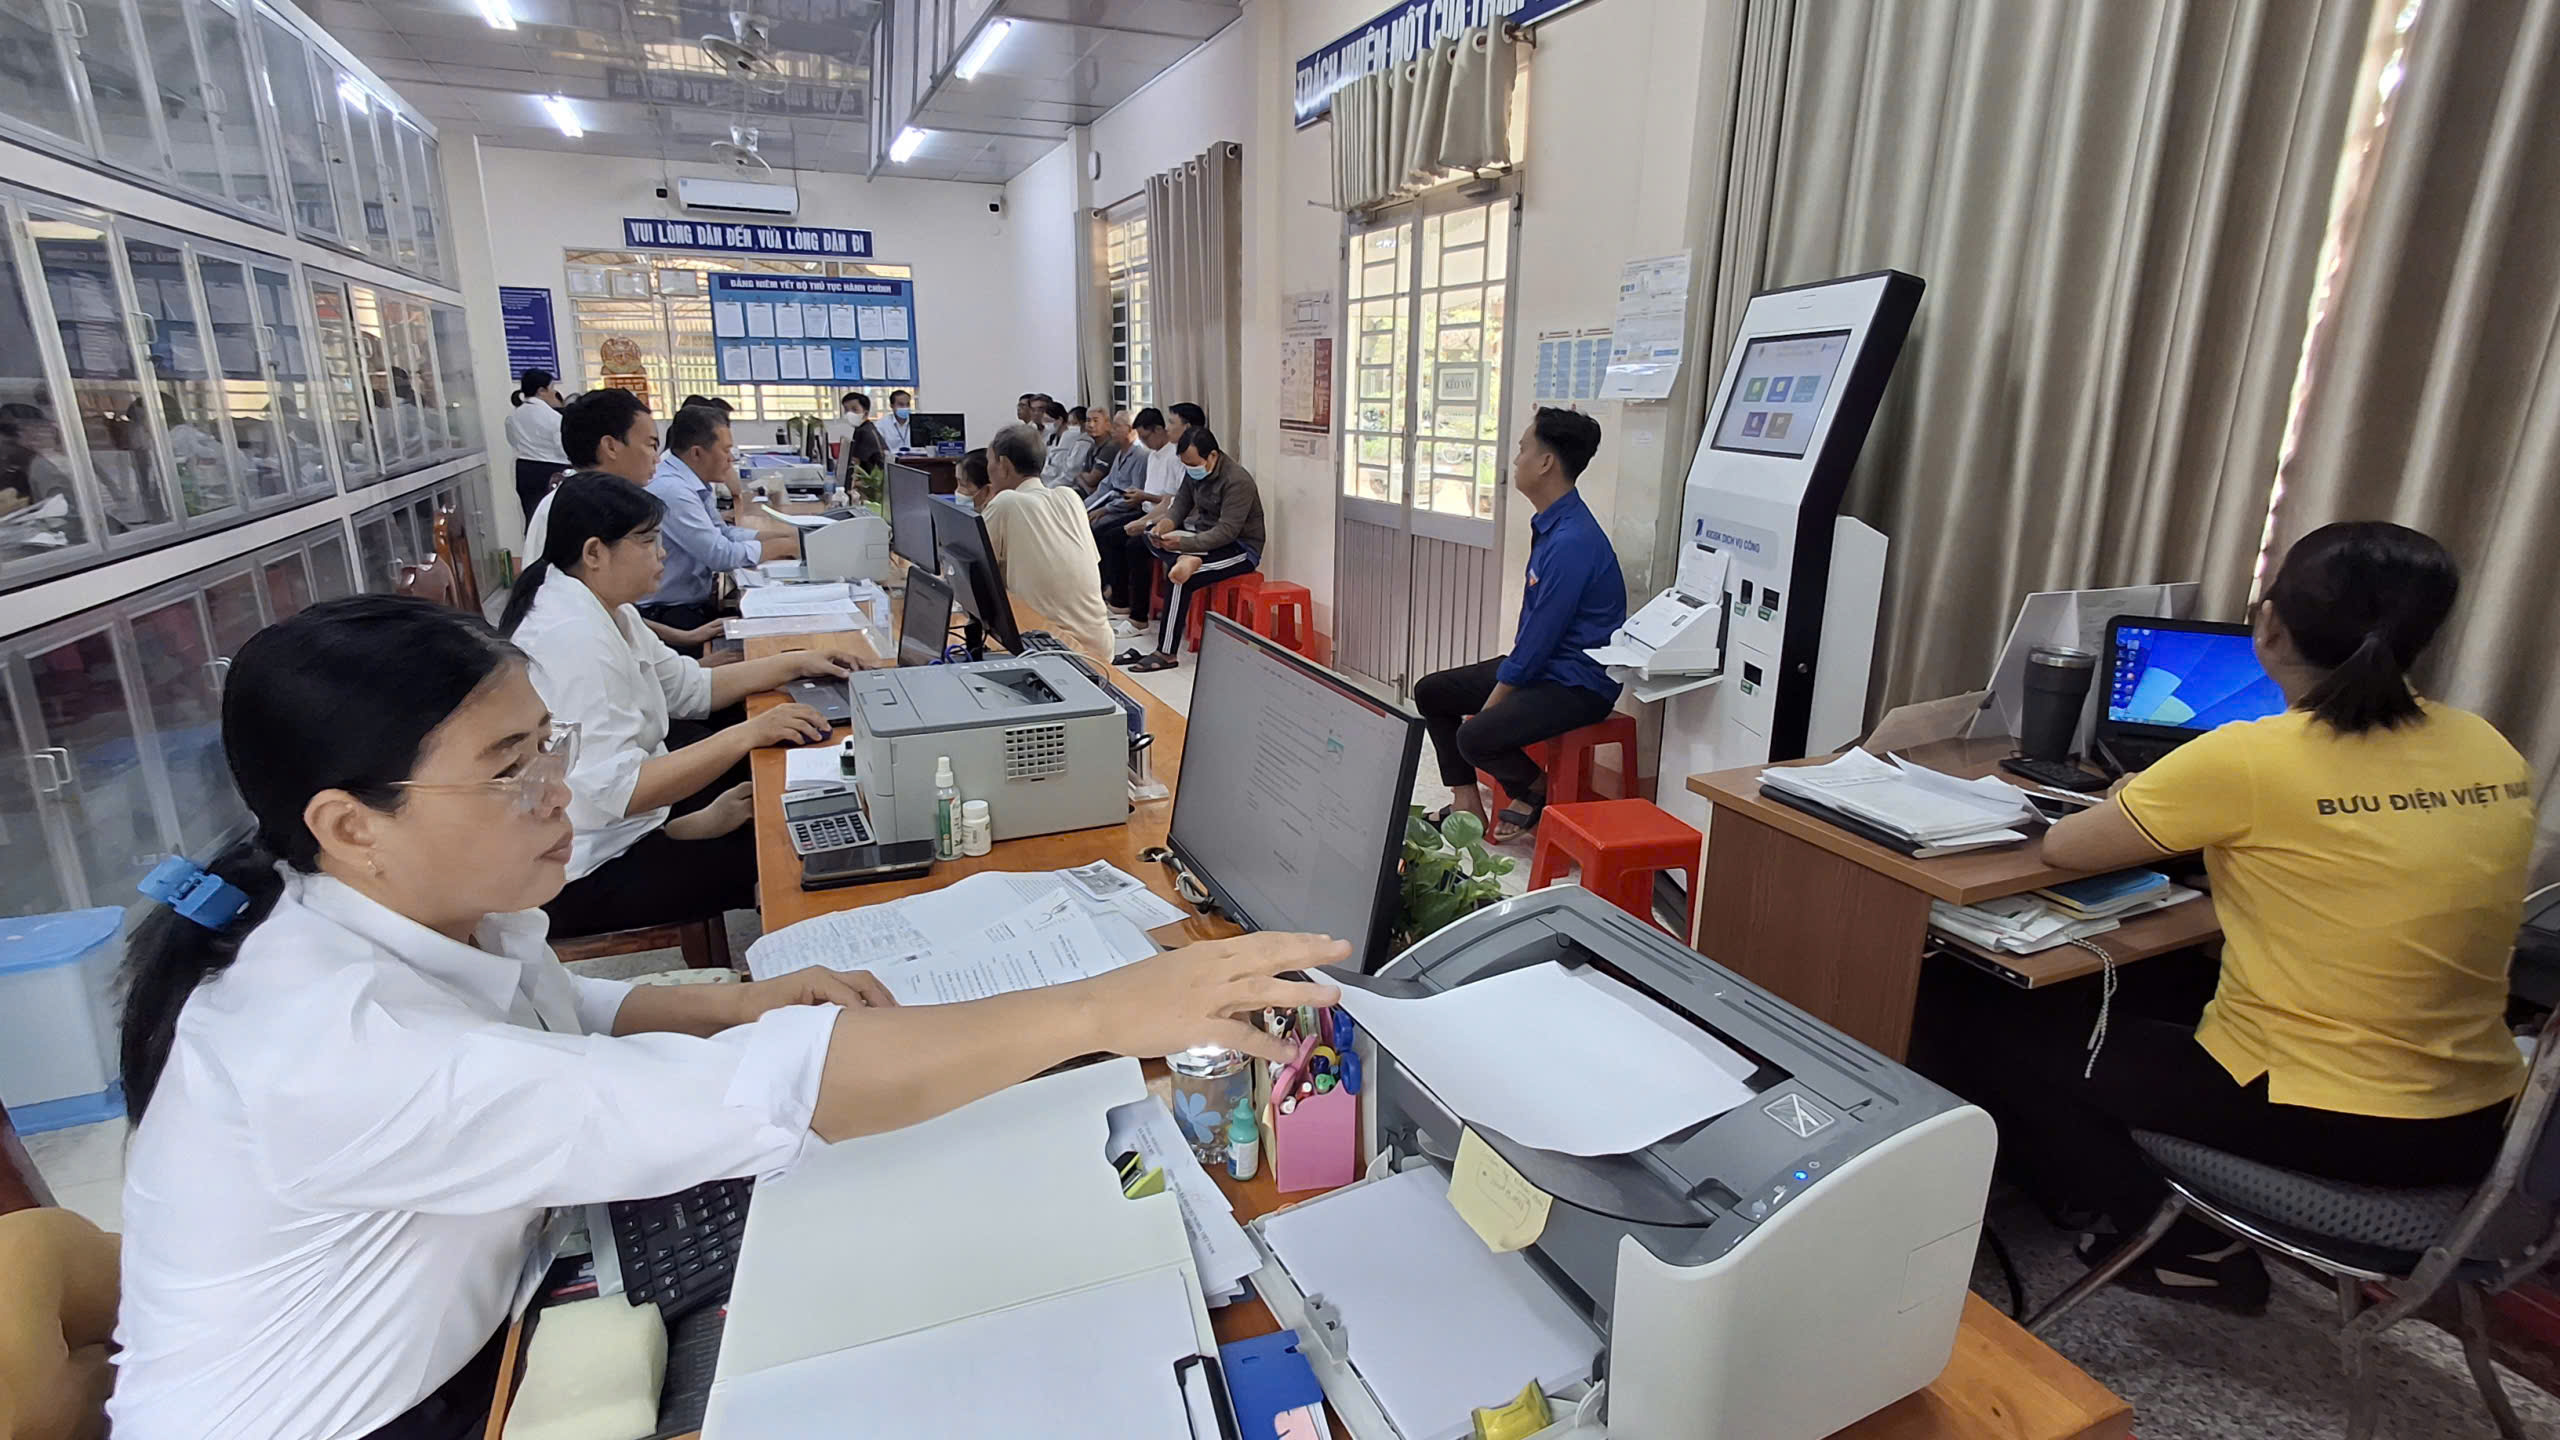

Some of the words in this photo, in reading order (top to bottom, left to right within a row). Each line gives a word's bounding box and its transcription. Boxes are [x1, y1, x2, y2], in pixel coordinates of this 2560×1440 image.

[630, 222, 655, 243] VUI
[657, 221, 694, 245] LÒNG
[696, 224, 723, 247] DÂN
[786, 227, 820, 251] LÒNG
[823, 231, 848, 253] DÂN
[851, 234, 865, 253] ĐI
[2316, 795, 2381, 815] BƯU
[2389, 788, 2448, 814] ĐIỆN
[2451, 783, 2499, 808] VIỆT
[2503, 781, 2529, 800] NA
